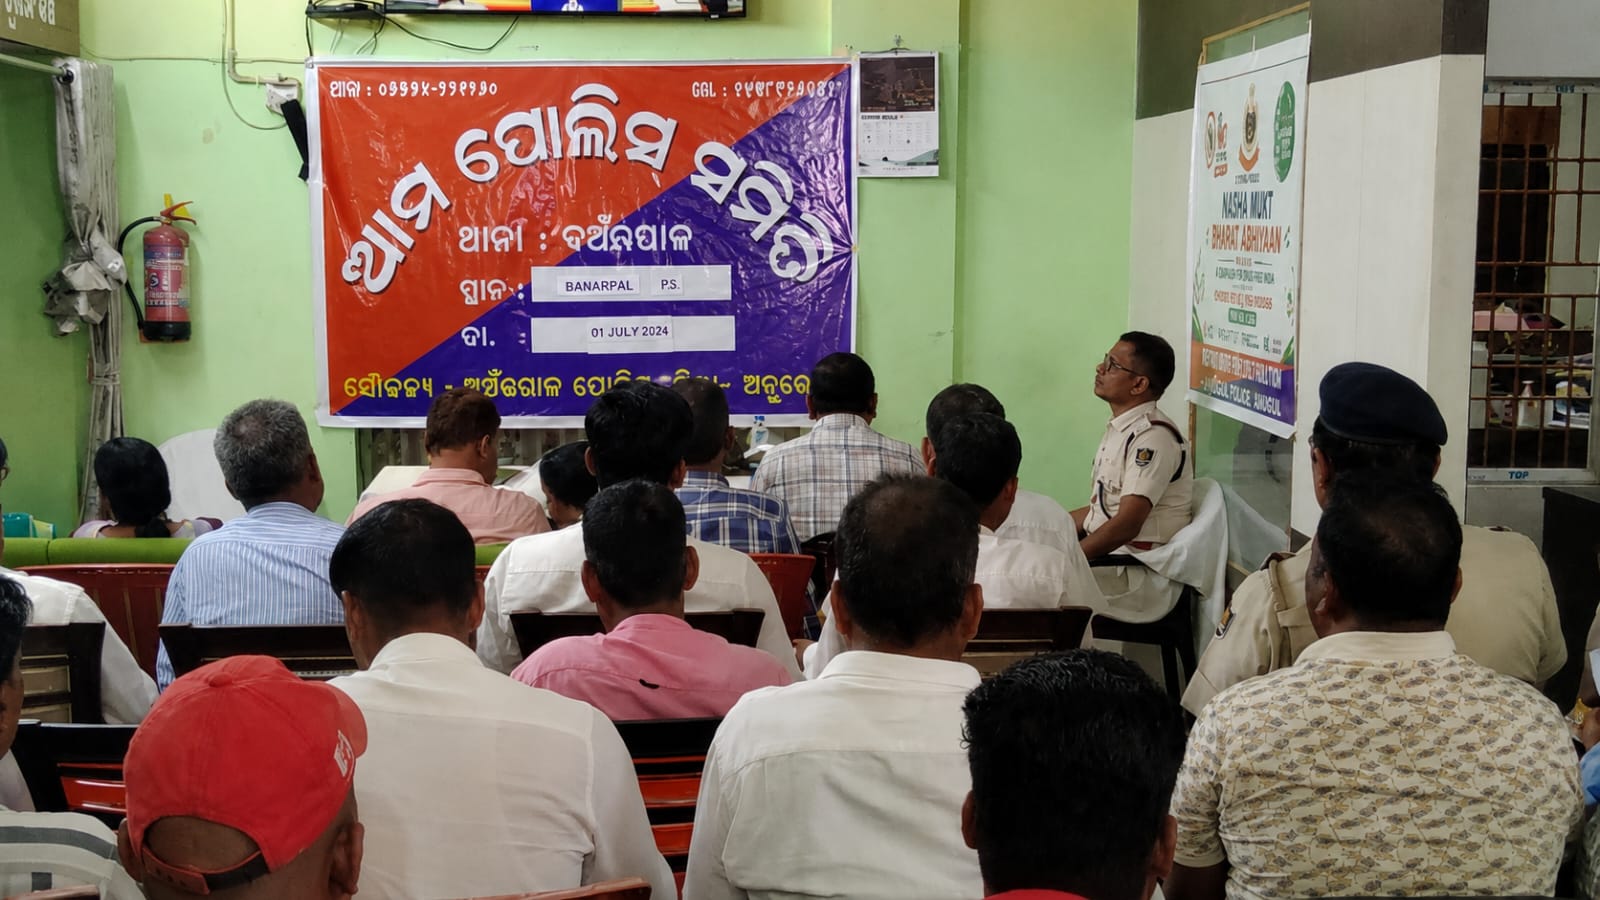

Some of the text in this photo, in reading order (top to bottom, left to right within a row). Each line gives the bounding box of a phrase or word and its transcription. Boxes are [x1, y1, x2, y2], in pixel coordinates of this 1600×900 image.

[454, 82, 678, 183] ପୋଲିସ
[690, 141, 834, 283] ସମିତି
[1222, 190, 1274, 220] NASHA MUKT
[458, 224, 523, 252] ଥାନା
[1211, 224, 1282, 254] BHARAT ABHIYAAN
[565, 278, 681, 292] BANARPAL P.S.
[591, 325, 669, 338] 01 JULY 2024
[1508, 470, 1529, 480] TOP
